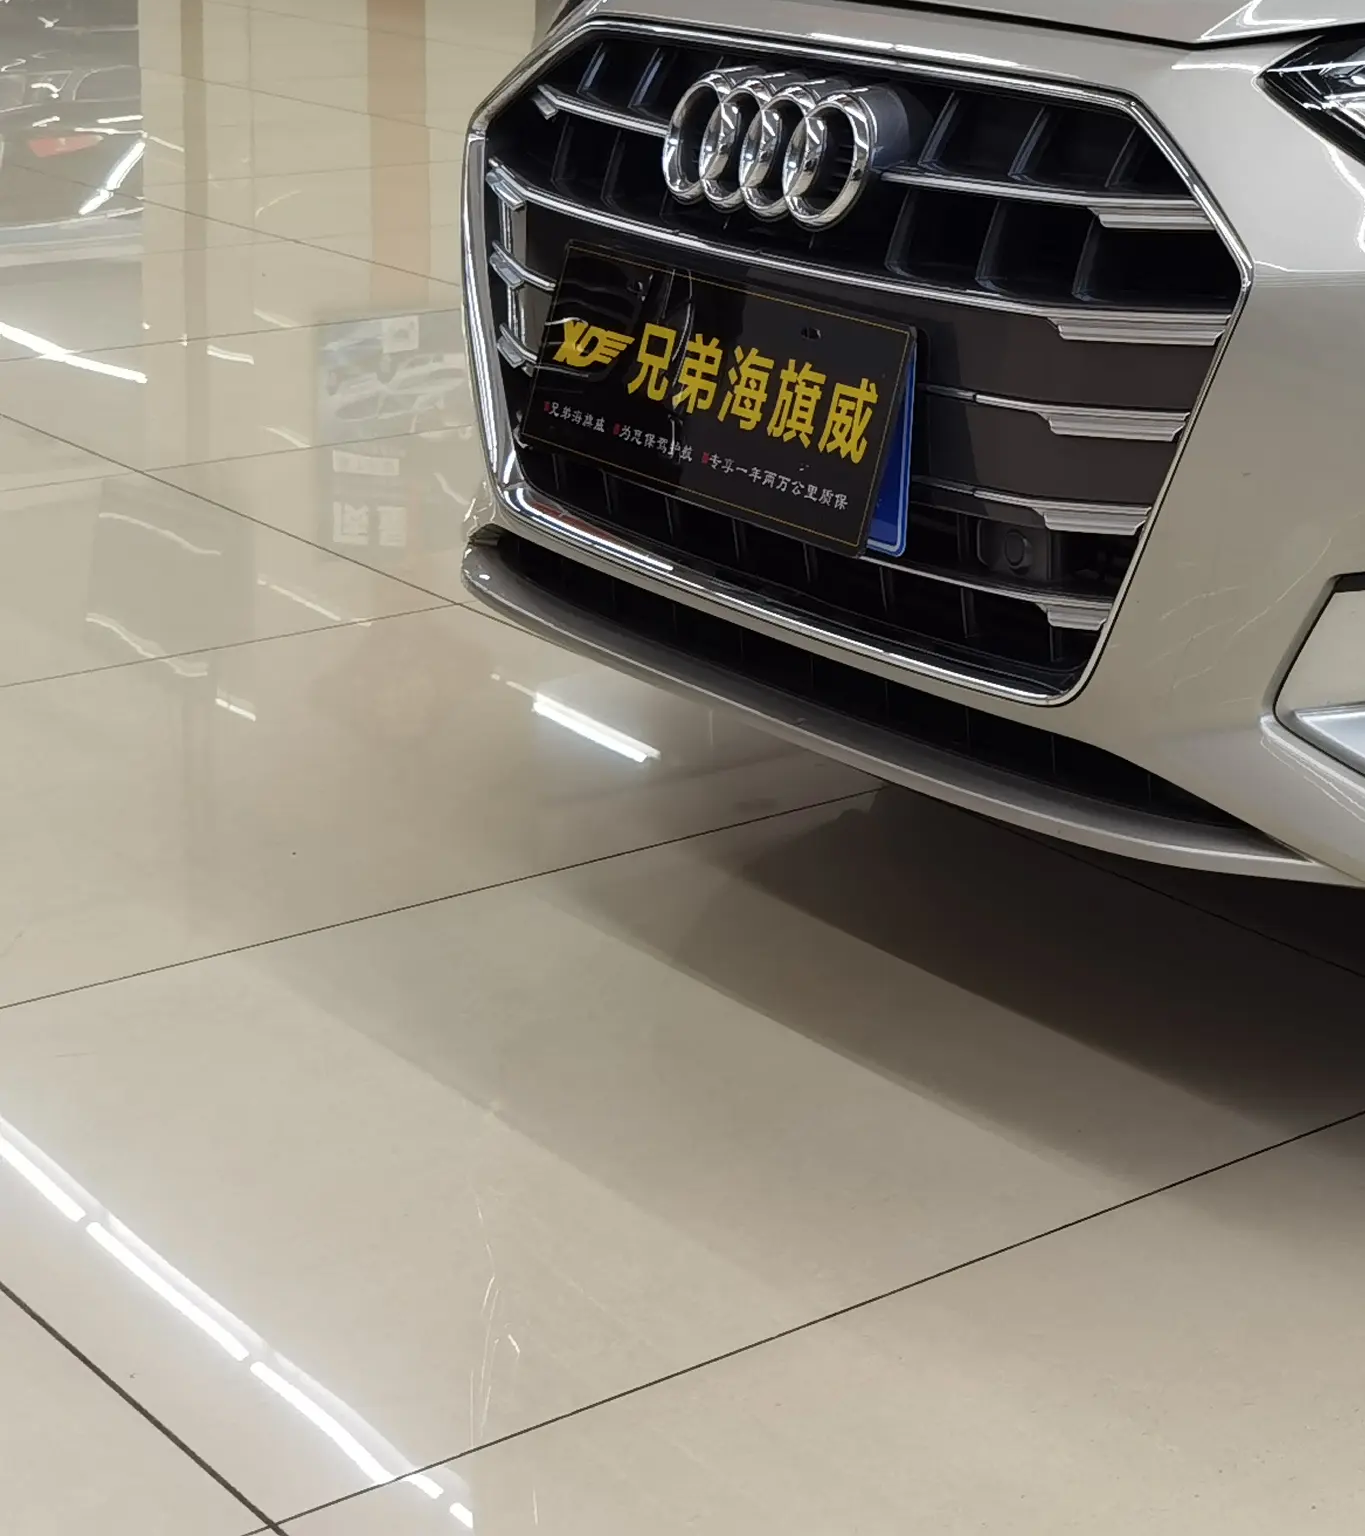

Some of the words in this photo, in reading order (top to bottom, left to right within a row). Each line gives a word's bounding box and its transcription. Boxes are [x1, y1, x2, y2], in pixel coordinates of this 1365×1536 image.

[626, 321, 879, 464] 兄弟海旗威
[548, 401, 605, 433] 兄弟海旗威
[708, 453, 849, 511] 专享一年两万公里质保
